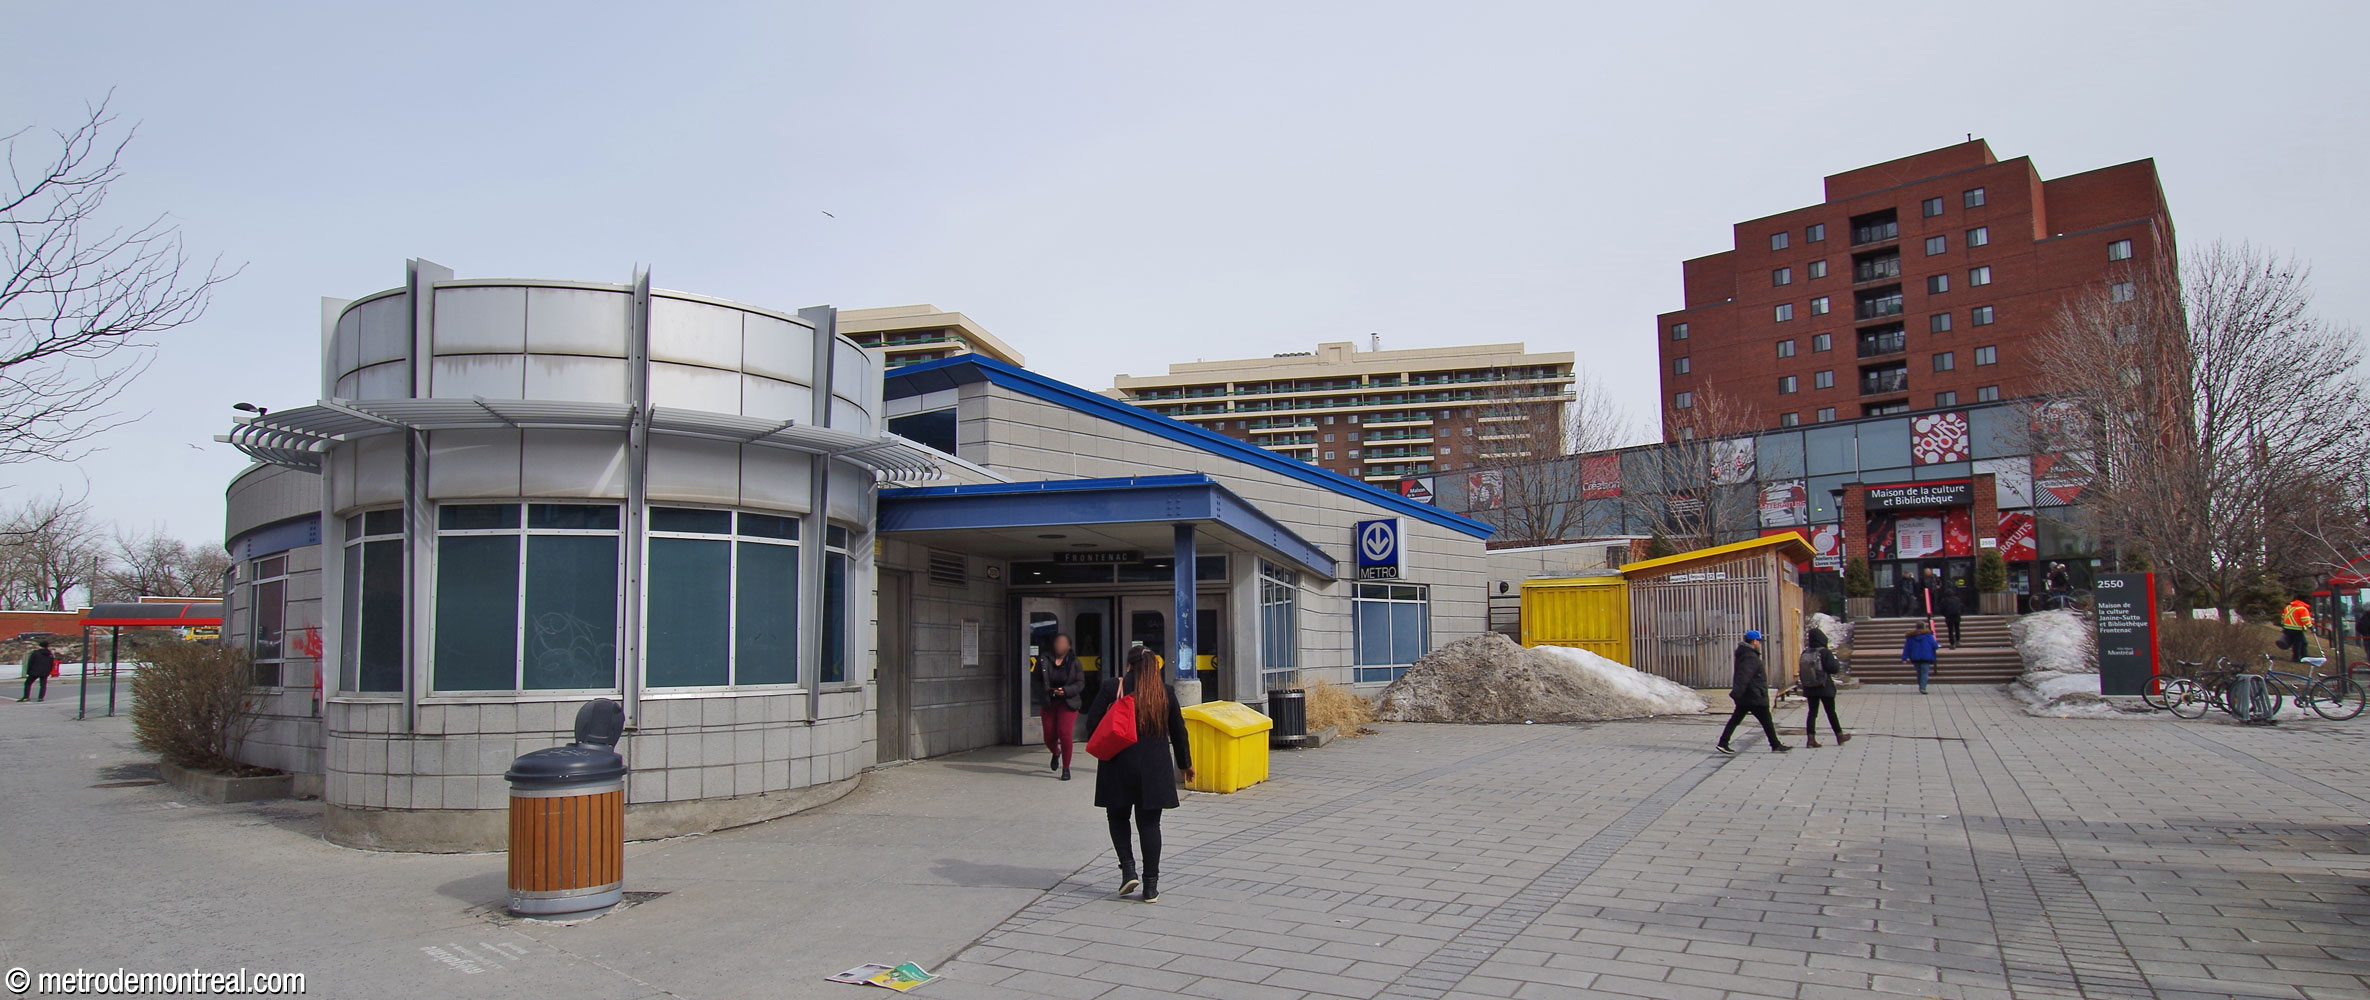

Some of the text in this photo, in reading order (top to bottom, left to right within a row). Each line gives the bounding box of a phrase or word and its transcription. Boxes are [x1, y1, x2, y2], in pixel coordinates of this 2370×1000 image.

[1913, 421, 1948, 459] POUR
[1932, 419, 1968, 455] TOUS
[1871, 484, 1965, 498] Maison de la culture
[1883, 494, 1953, 506] et Bibliothèque
[1065, 553, 1128, 562] FRONTENAC
[1360, 566, 1397, 579] METRO
[2097, 580, 2124, 589] 2550
